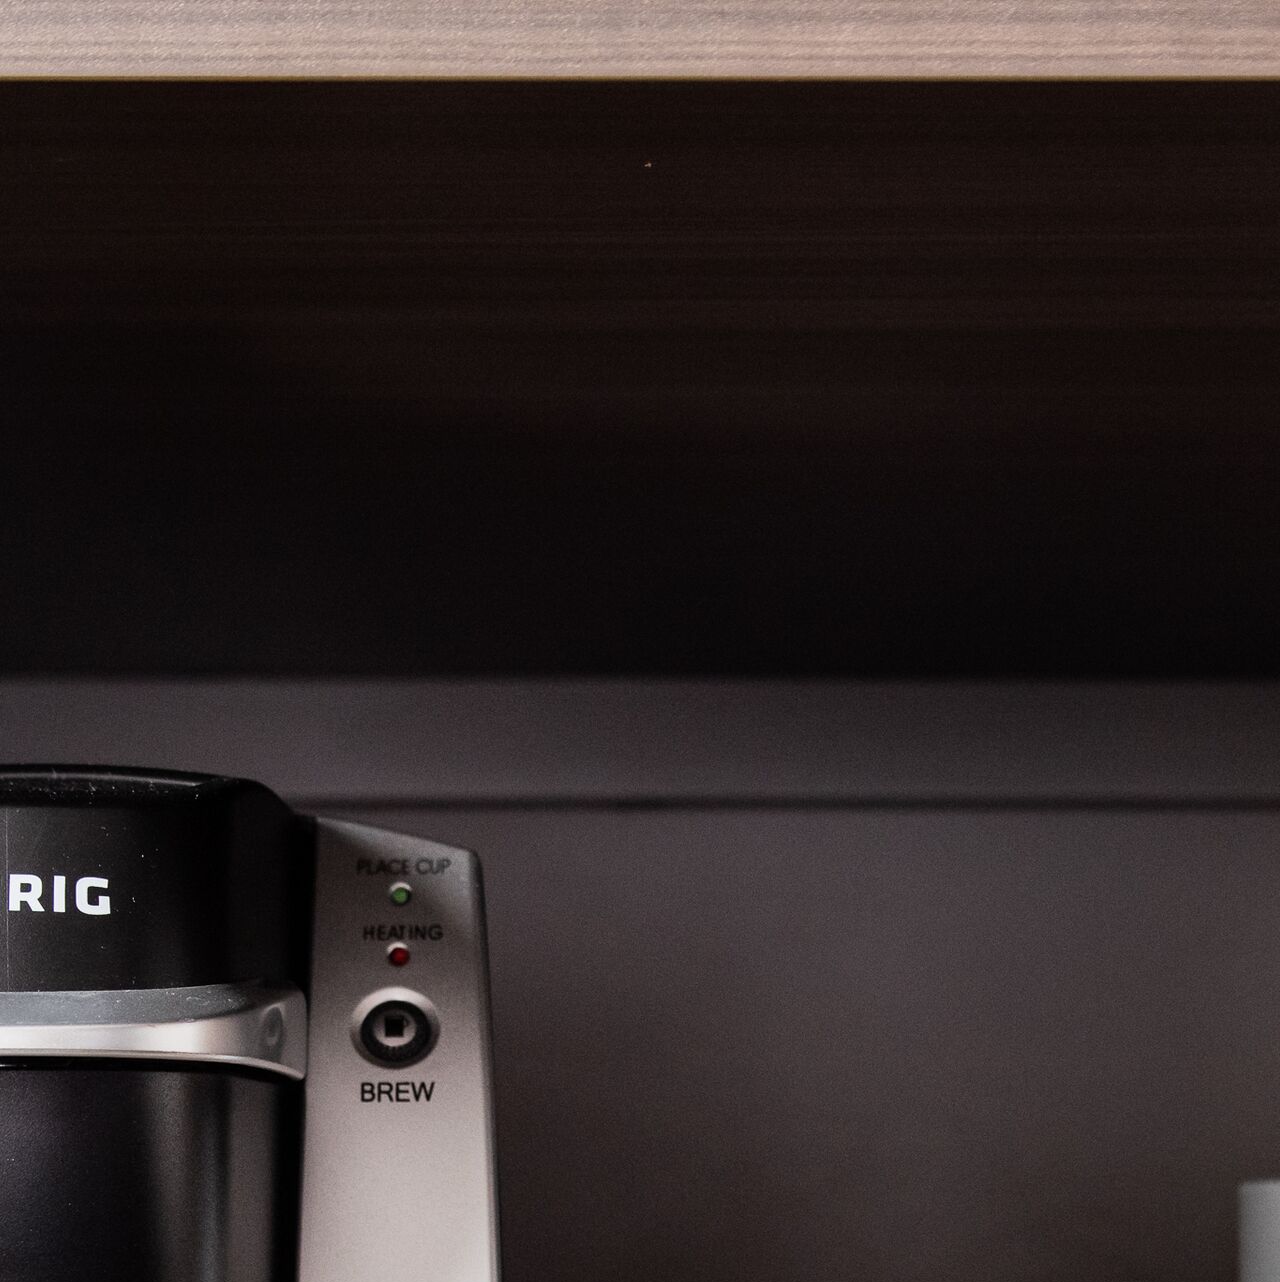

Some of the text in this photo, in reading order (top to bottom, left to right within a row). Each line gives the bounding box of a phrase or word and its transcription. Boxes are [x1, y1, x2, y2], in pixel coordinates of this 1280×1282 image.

[356, 859, 451, 876] PLACE CUP
[362, 924, 444, 942] HEATING
[360, 1081, 435, 1102] BREW
